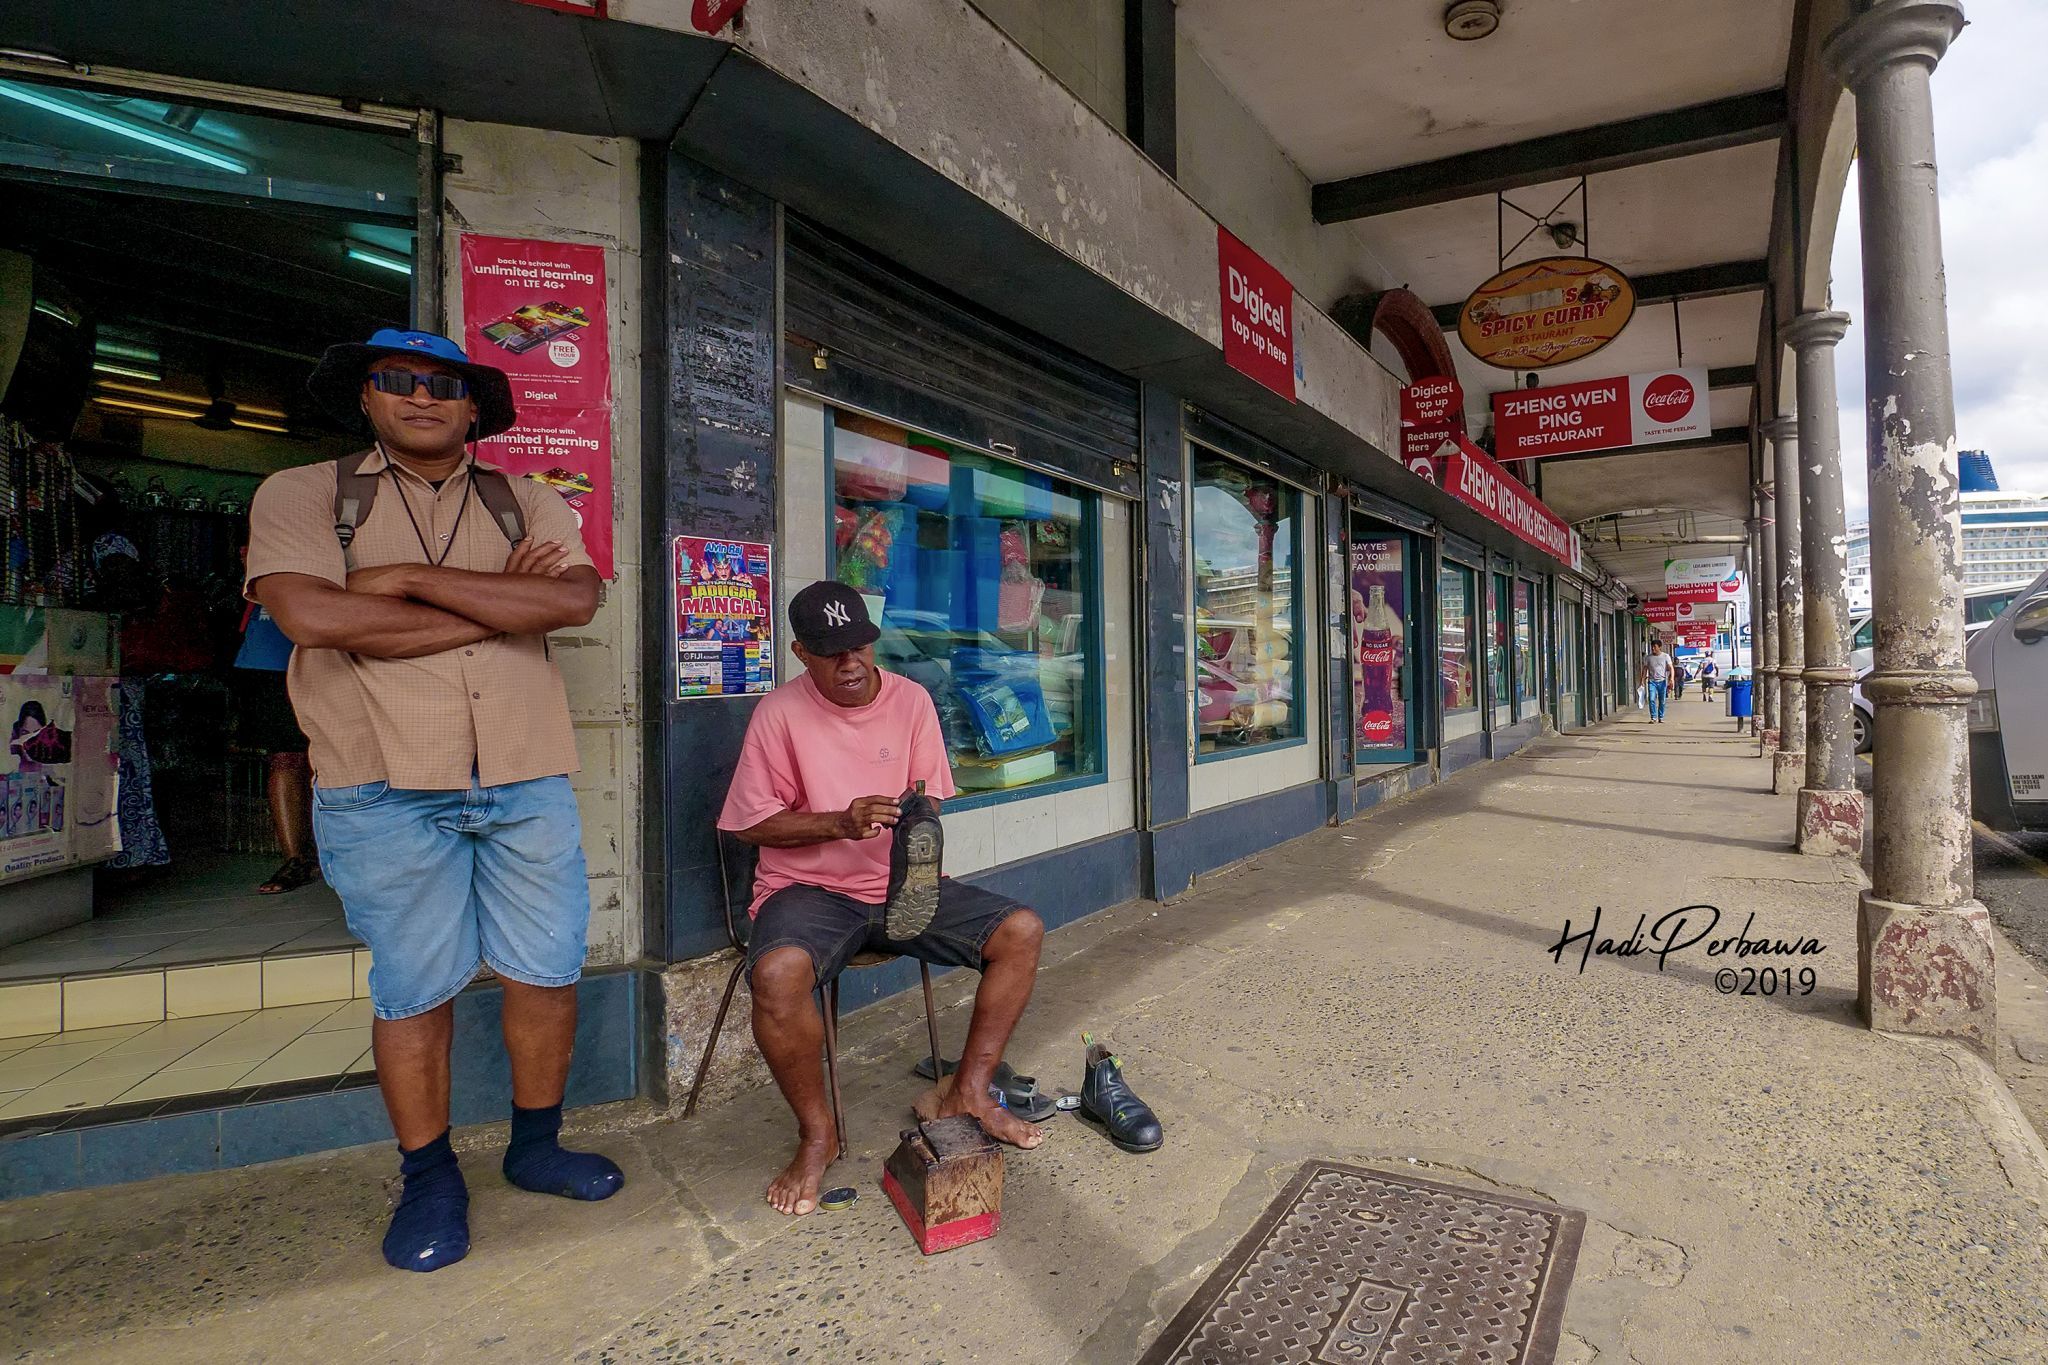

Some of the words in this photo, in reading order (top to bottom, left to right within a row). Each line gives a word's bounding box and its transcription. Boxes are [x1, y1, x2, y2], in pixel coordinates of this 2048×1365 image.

[528, 260, 553, 268] school
[554, 262, 570, 270] with
[474, 265, 537, 278] unlimited
[540, 268, 594, 284] learning
[504, 279, 520, 287] on
[524, 279, 540, 288] LTE
[543, 281, 566, 289] 4G+
[1229, 266, 1287, 337] Digicel
[1480, 314, 1537, 338] SPICY
[1542, 300, 1610, 325] CURRY
[1231, 314, 1250, 344] top
[1252, 330, 1265, 355] up
[1267, 338, 1287, 365] here
[1512, 326, 1575, 345] RESTAURANT
[553, 345, 575, 353] FREE
[524, 390, 558, 401] Digicel
[1410, 381, 1454, 399] Digicel
[1416, 401, 1432, 410] top
[1435, 398, 1448, 408] up
[1504, 395, 1566, 417] ZHENG
[1571, 387, 1617, 407] WEN
[1420, 409, 1444, 418] here
[1538, 411, 1583, 430] PING
[1407, 430, 1450, 442] Recharge
[1518, 426, 1605, 447] RESTAURANT
[1673, 425, 1697, 434] FEELING
[545, 436, 599, 450] learning
[1408, 444, 1430, 452] Here
[528, 446, 544, 454] LTE
[548, 447, 570, 455] 4G+
[1460, 451, 1496, 511] ZHENG
[1497, 479, 1516, 525] WEN
[1517, 496, 1534, 536] PING
[1534, 510, 1568, 556] RESTAURANT
[704, 541, 727, 552] Alvin
[691, 585, 757, 600] JADUGAR
[682, 596, 766, 617] MANGAL
